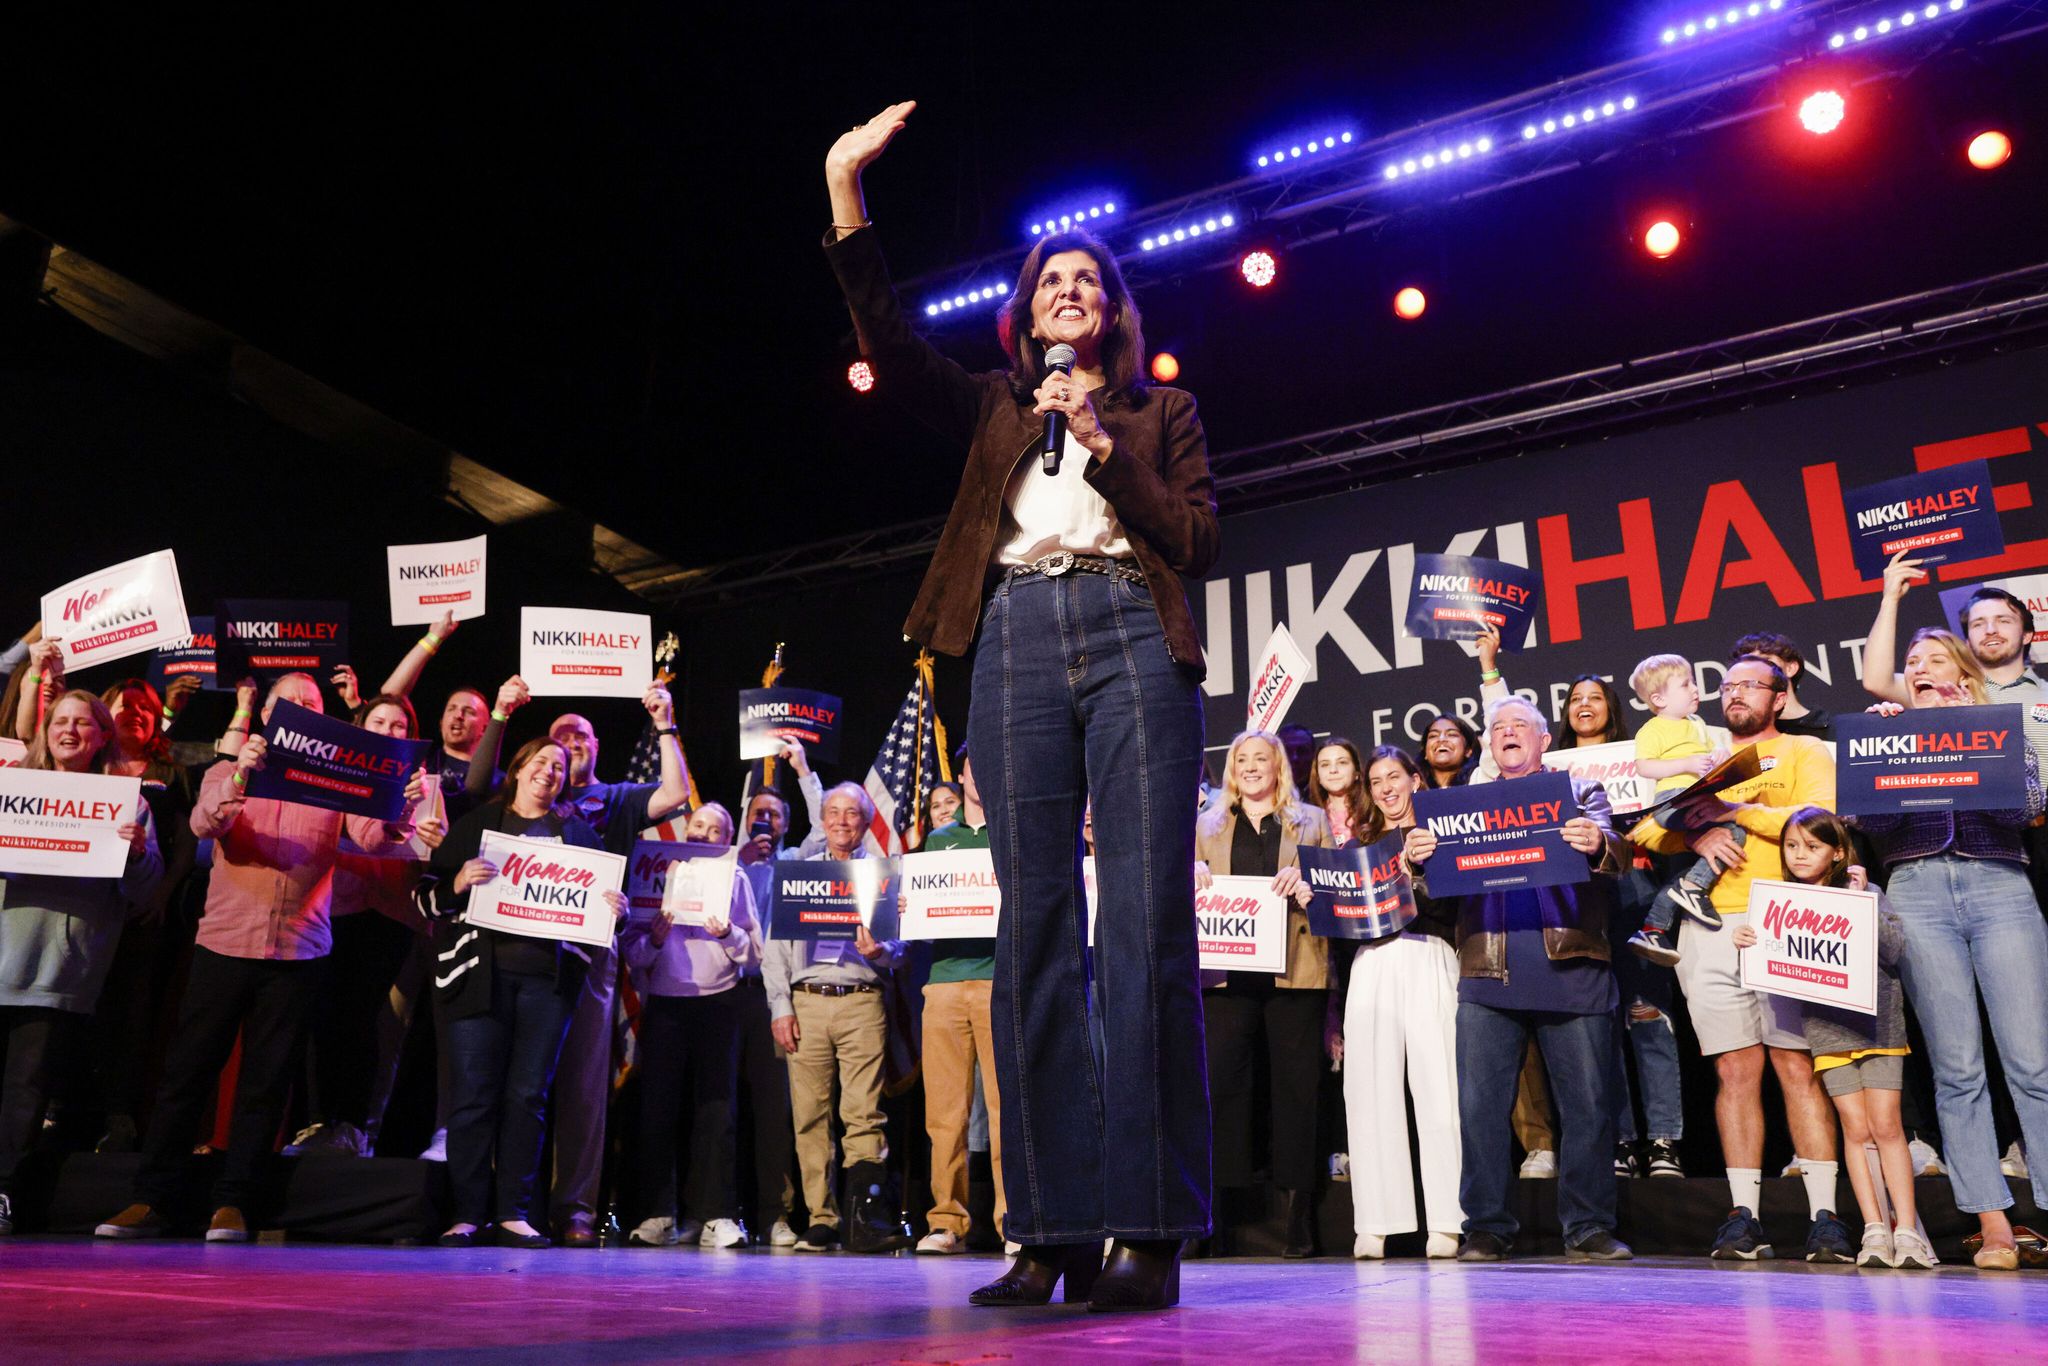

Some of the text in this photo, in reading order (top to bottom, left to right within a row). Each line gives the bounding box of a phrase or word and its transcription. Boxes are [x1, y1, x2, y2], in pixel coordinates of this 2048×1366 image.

[1888, 513, 1947, 532] FOR PRESIDENT
[1886, 531, 1959, 551] NikkiHaley.com
[1462, 595, 1499, 605] PRESIDENT
[74, 624, 154, 651] NikkiHaley.com
[252, 657, 317, 668] NikkiHaley.com
[555, 665, 620, 675] NikkiHaley.com
[305, 758, 368, 778] FOR PRESIDENT
[1888, 755, 1963, 765] FOR PRESIDENT
[290, 772, 369, 795] NikkiHaley.com
[1880, 775, 1973, 788] NikkiHaley.com
[35, 820, 81, 829] PRESIDENT
[2, 838, 86, 851] NikkiHaley.com
[1464, 830, 1528, 845] FOR PRESIDENT
[1461, 851, 1541, 867] NikkiHaley.com
[501, 852, 597, 888] Women
[501, 882, 587, 908] FOR NIKKI
[782, 877, 890, 896] NIKKIHAY
[1196, 887, 1262, 916] omen
[501, 904, 581, 924] NikkiHaley.com
[804, 913, 862, 922] NikkiHaley.co
[930, 907, 991, 916] NikkiHaley.com
[1763, 899, 1853, 940] Women
[1197, 916, 1255, 938] NIKKI
[1764, 934, 1847, 966] FOR NIKKI
[1771, 963, 1845, 985] NikkiHaley.com
